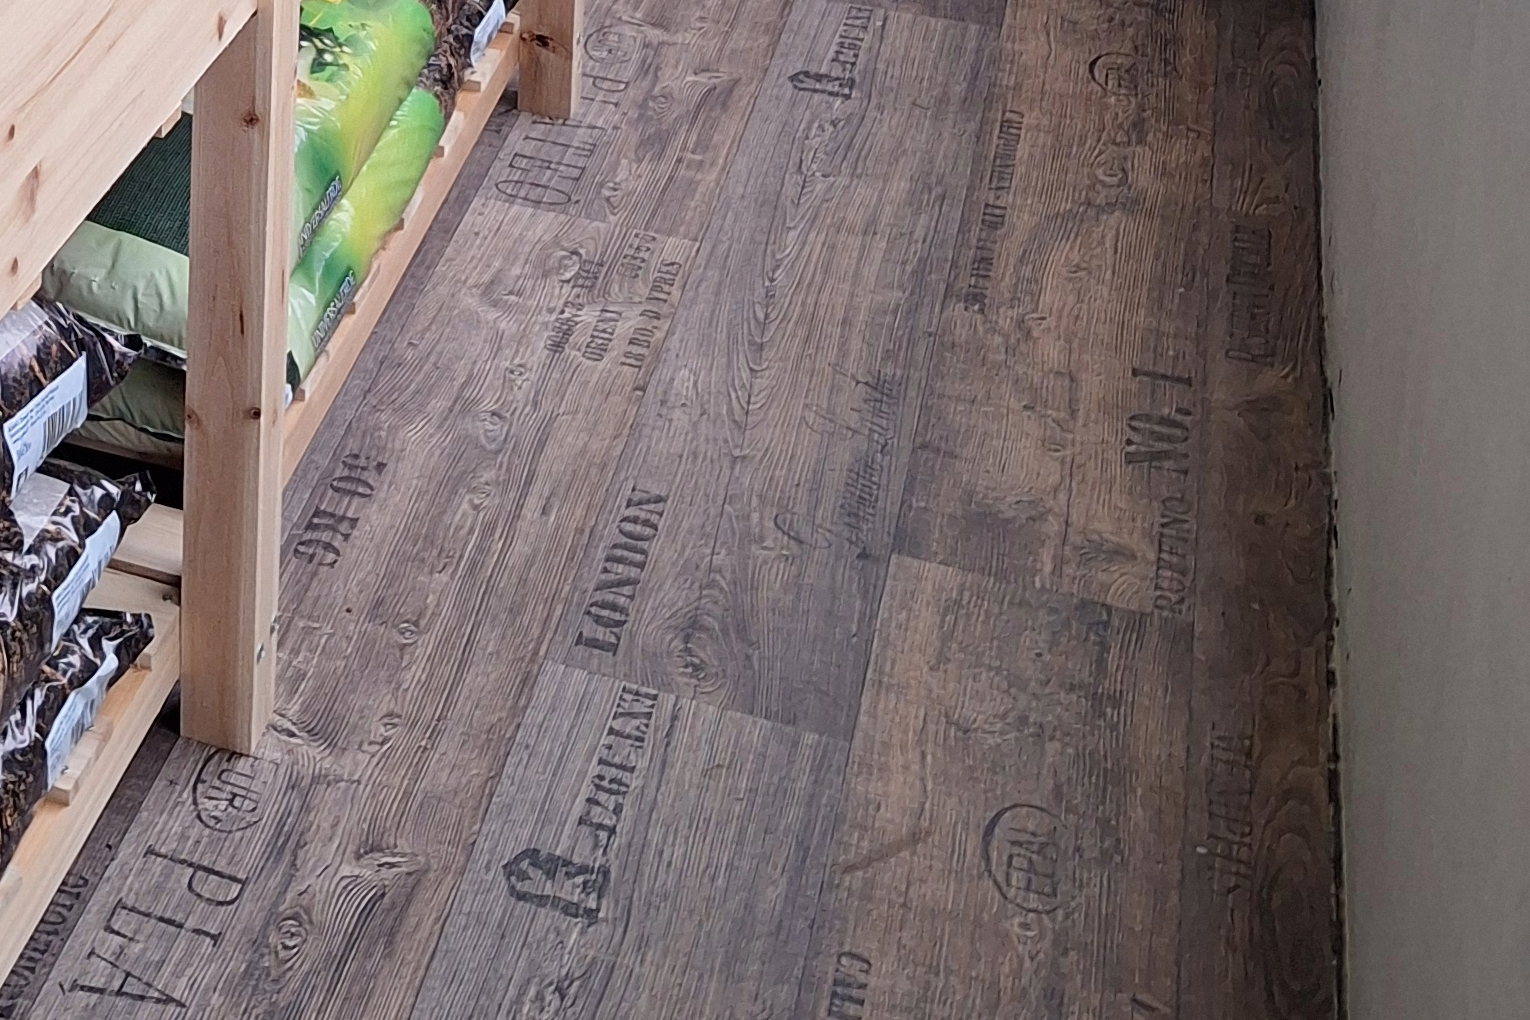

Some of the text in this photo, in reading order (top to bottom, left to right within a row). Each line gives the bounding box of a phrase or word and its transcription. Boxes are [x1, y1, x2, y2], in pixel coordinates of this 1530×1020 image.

[620, 352, 645, 368] 18
[646, 259, 682, 303] YPRES
[293, 509, 361, 568] KG
[575, 485, 668, 656] LONDON
